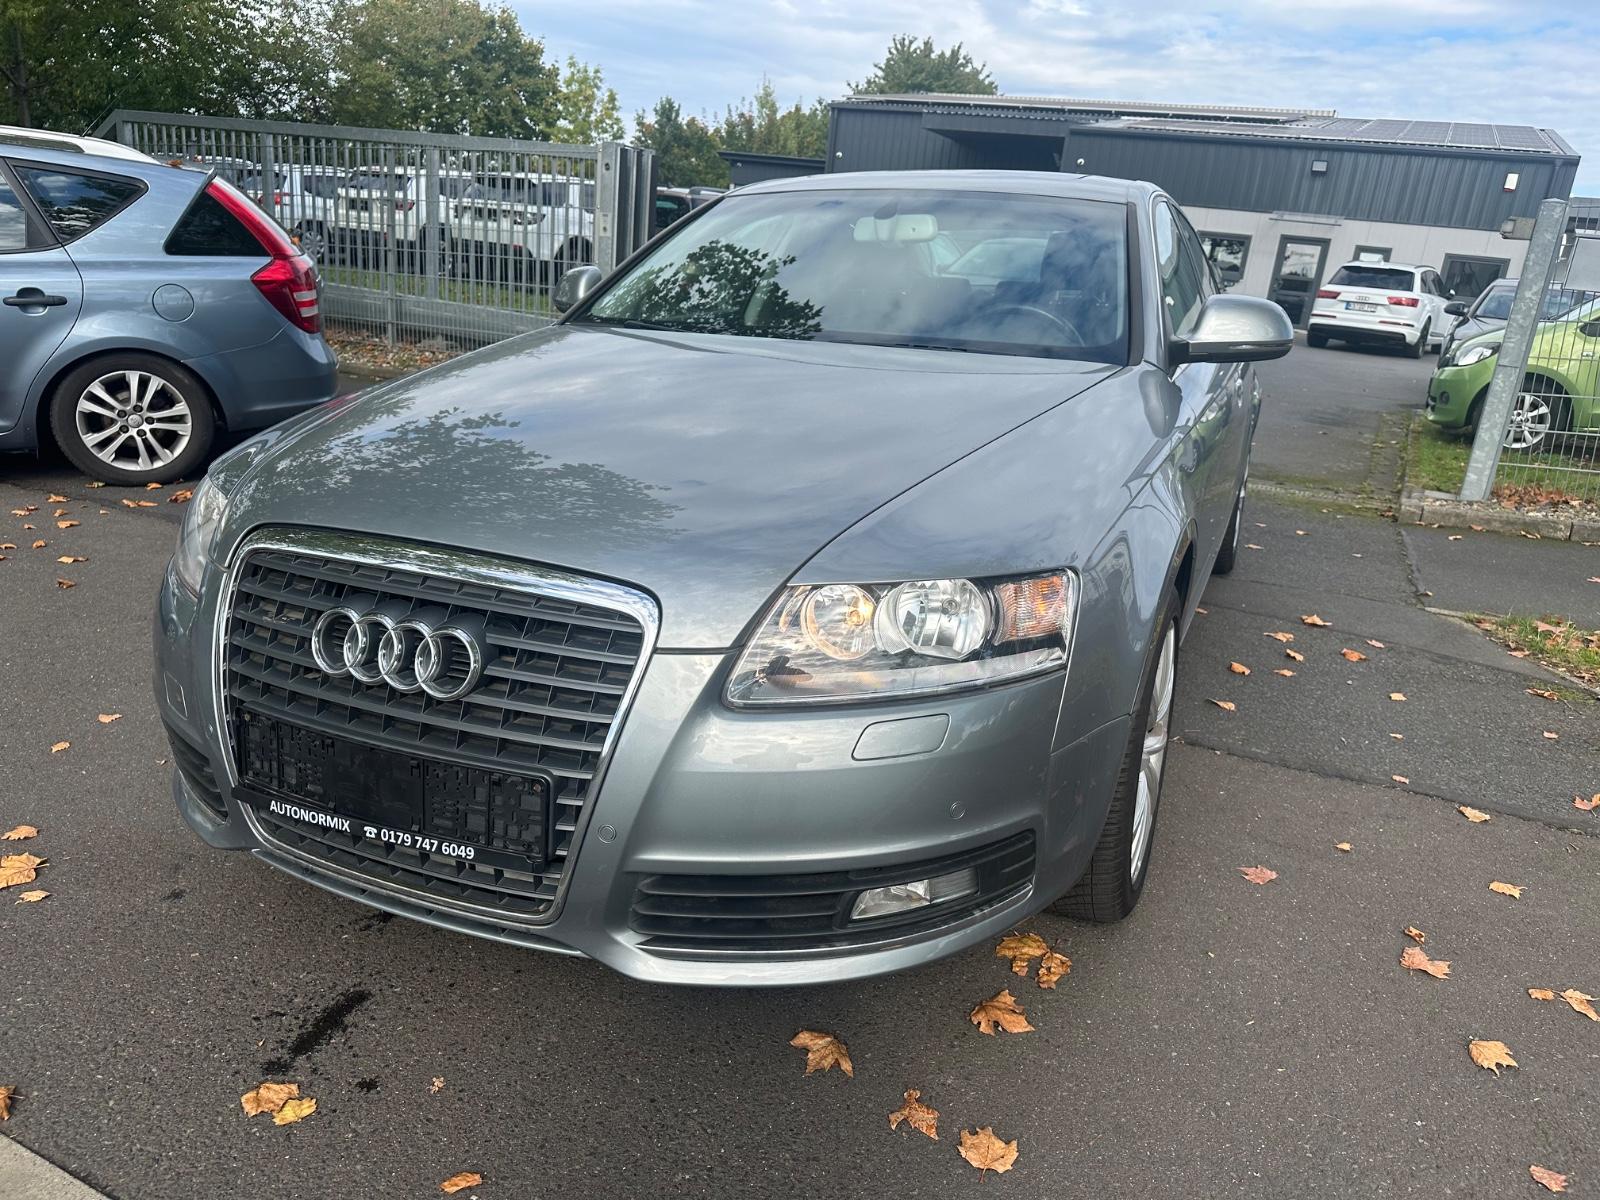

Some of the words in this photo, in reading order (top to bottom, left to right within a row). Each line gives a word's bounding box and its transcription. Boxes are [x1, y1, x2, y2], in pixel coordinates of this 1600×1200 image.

[269, 800, 351, 833] AUTONORMIX
[380, 828, 412, 847] 0179
[414, 835, 438, 852] 747
[441, 842, 475, 860] 6049
